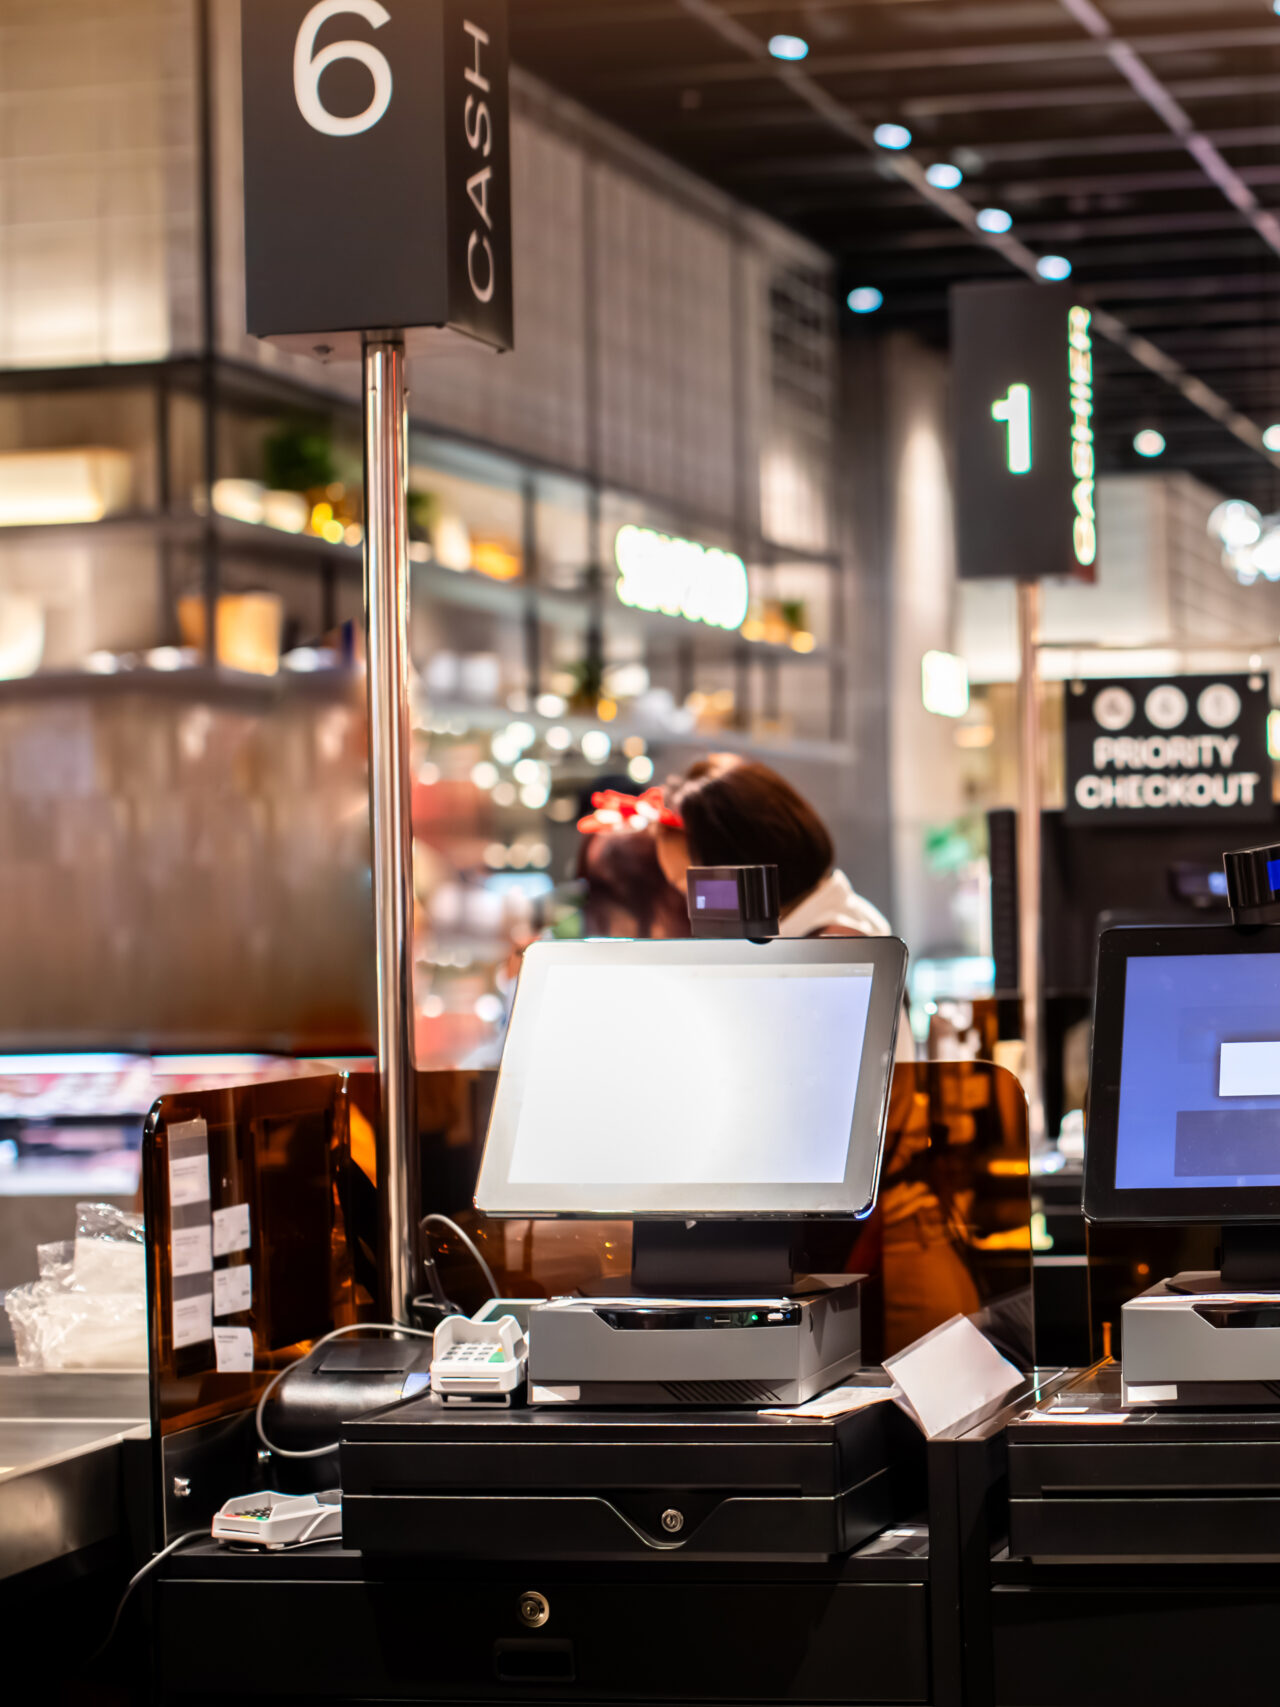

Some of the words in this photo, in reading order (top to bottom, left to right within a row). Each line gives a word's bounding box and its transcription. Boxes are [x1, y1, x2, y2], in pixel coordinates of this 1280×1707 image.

[294, 0, 393, 136] 6
[463, 19, 495, 303] CASH
[991, 383, 1032, 474] 1
[1074, 772, 1260, 810] CHECKOUT
[1093, 734, 1240, 770] PRIORITY
